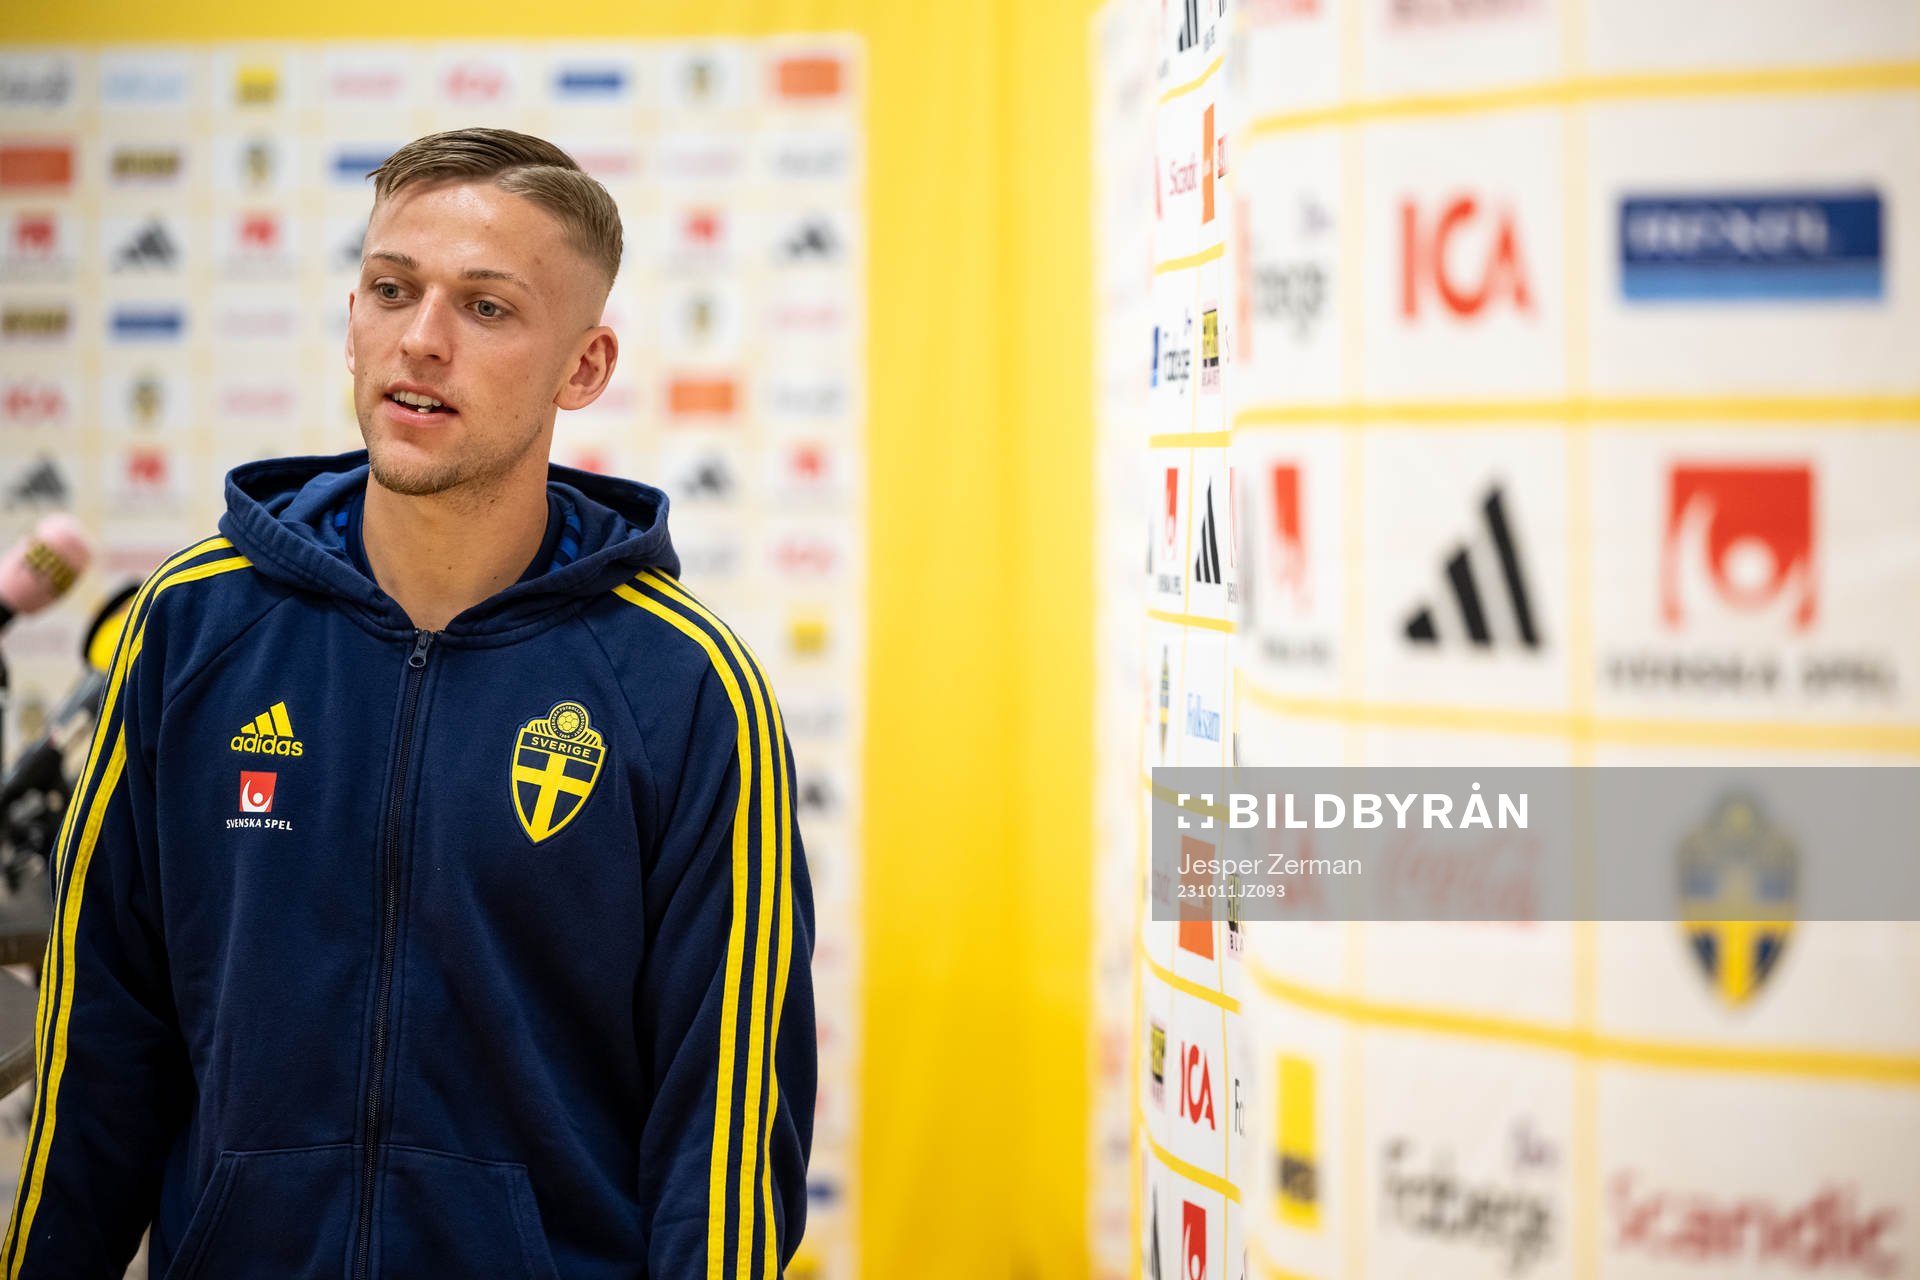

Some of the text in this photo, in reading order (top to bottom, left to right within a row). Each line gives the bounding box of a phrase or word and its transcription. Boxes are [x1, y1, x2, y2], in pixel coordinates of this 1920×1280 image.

[1399, 193, 1536, 324] ICA
[230, 733, 304, 756] adidas
[531, 736, 592, 758] SVERIGE
[226, 818, 293, 831] SVENSKA SPEL
[1179, 1041, 1216, 1131] ICA
